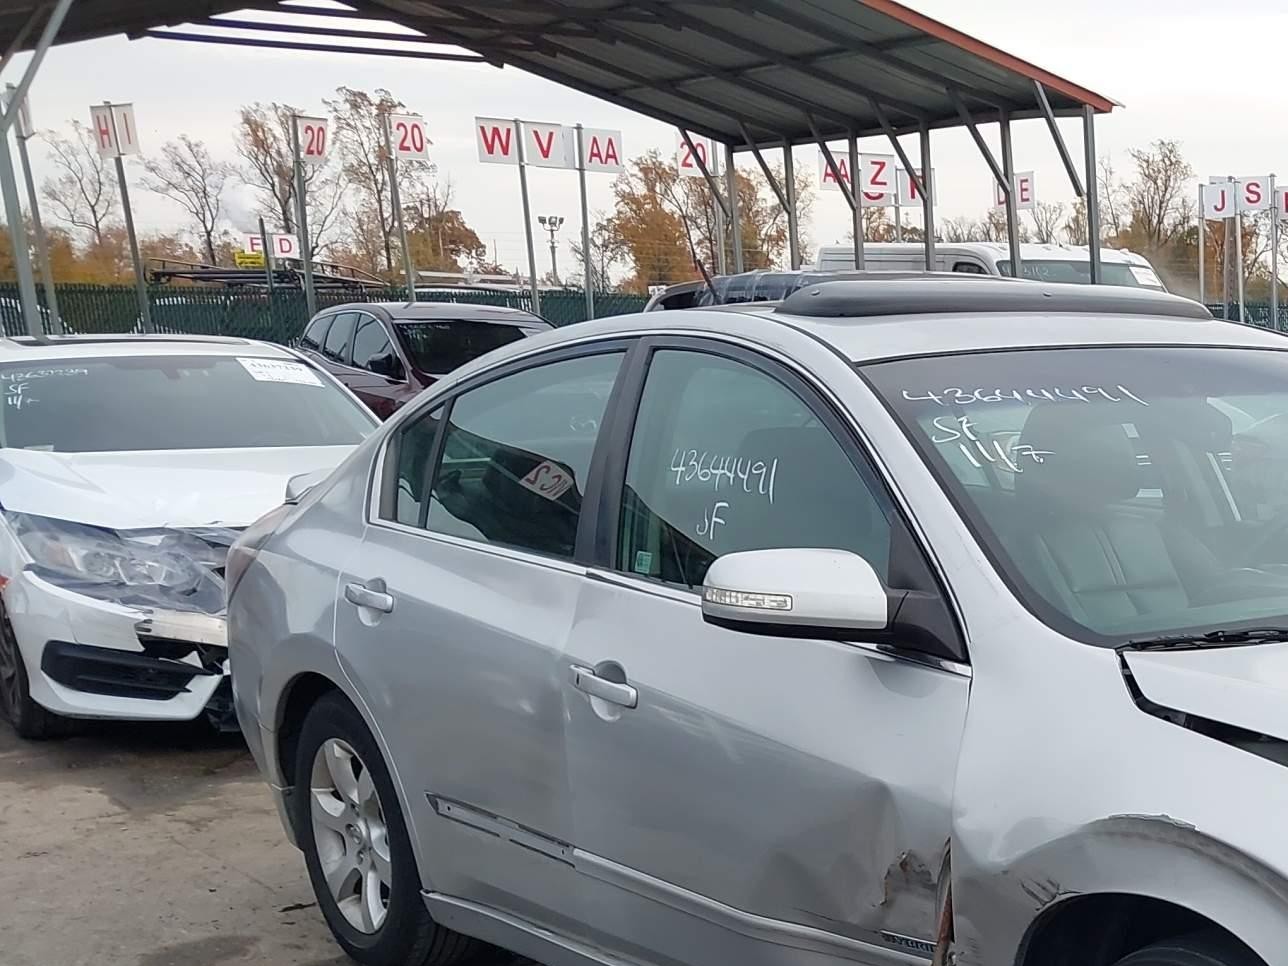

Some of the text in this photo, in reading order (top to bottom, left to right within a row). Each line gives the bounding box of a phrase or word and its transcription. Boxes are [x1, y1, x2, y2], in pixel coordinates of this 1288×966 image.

[96, 114, 112, 149] H
[305, 125, 325, 156] 20
[396, 122, 424, 152] 20
[480, 125, 511, 156] W
[533, 129, 554, 159] V
[588, 136, 619, 165] AA
[680, 141, 707, 168] 20
[870, 161, 887, 186] Z
[1020, 179, 1030, 203] E
[1213, 190, 1226, 212] J
[1245, 182, 1261, 204] S
[279, 238, 292, 253] D
[903, 384, 1149, 406] 43644491
[671, 448, 777, 504] 43644491
